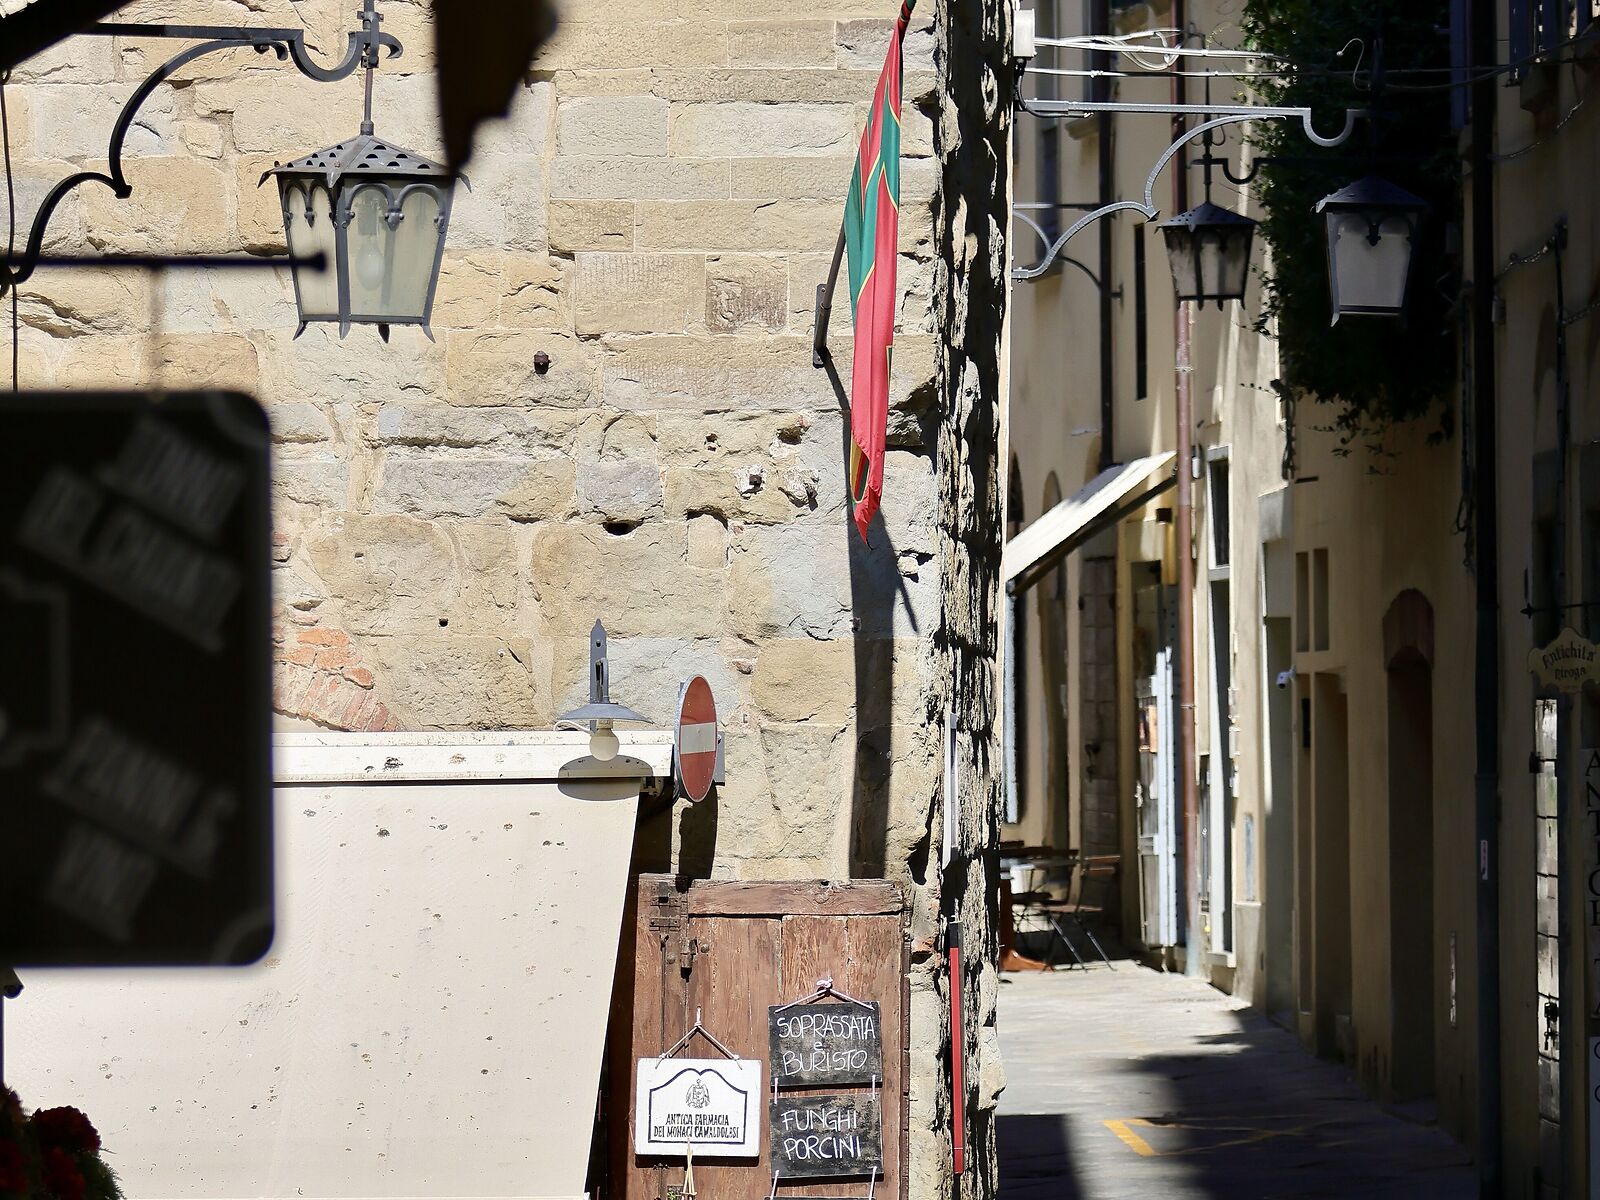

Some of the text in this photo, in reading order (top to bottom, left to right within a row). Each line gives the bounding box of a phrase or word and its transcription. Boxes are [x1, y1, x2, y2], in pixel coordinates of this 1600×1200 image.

[777, 1013, 876, 1040] SOPRASSATA
[782, 1049, 868, 1076] BURISTO
[653, 1125, 665, 1138] DEI
[666, 1125, 693, 1138] MONACI
[665, 1113, 730, 1127] ANTICA FARMACIA
[780, 1108, 857, 1132] FUNGHI
[783, 1135, 861, 1161] PORCINI
